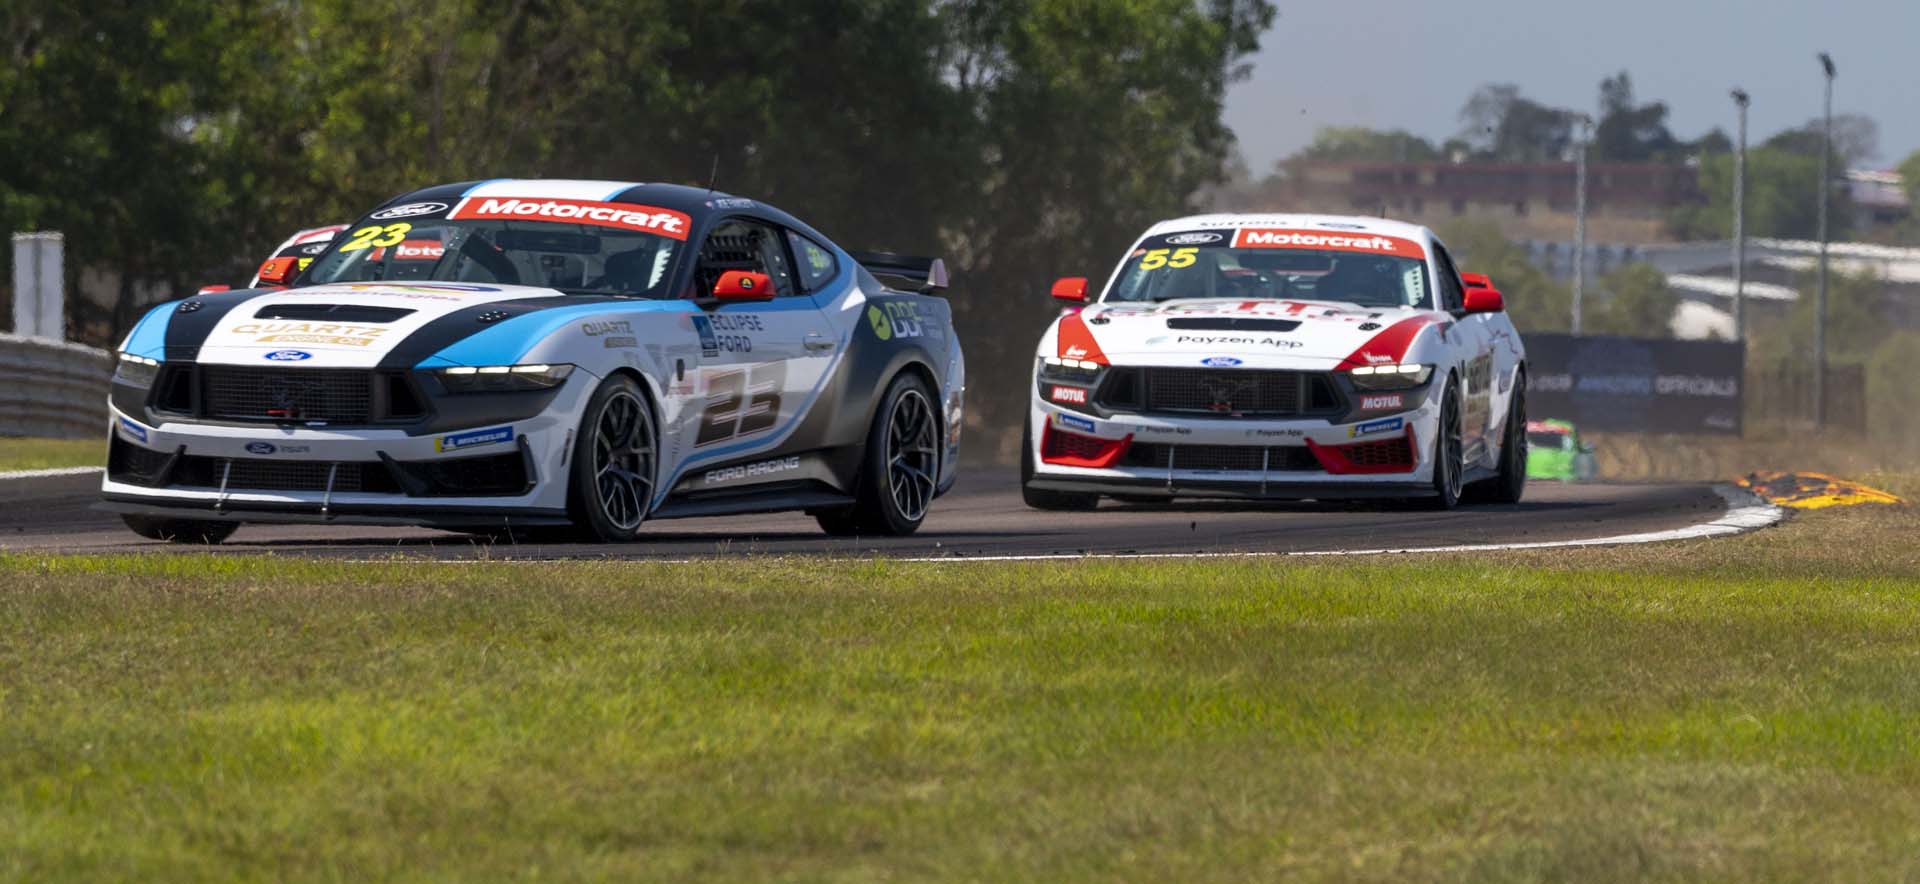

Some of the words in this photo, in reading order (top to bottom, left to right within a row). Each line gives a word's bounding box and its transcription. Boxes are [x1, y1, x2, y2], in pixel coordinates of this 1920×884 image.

[477, 199, 683, 233] Motorcraft
[339, 222, 412, 252] 23
[1246, 231, 1393, 250] Motorcraft
[1138, 247, 1199, 270] 55
[231, 323, 389, 337] QUARTZ
[581, 320, 635, 337] QUARTZ
[709, 314, 765, 332] ECLIPSE
[716, 335, 753, 353] FORD
[1177, 334, 1256, 345] Payzen
[1261, 337, 1304, 348] App
[694, 359, 788, 448] 23
[1053, 387, 1085, 403] MOTUL
[1363, 396, 1402, 409] MOTUL
[705, 465, 745, 483] FORD
[746, 456, 800, 477] RACING
